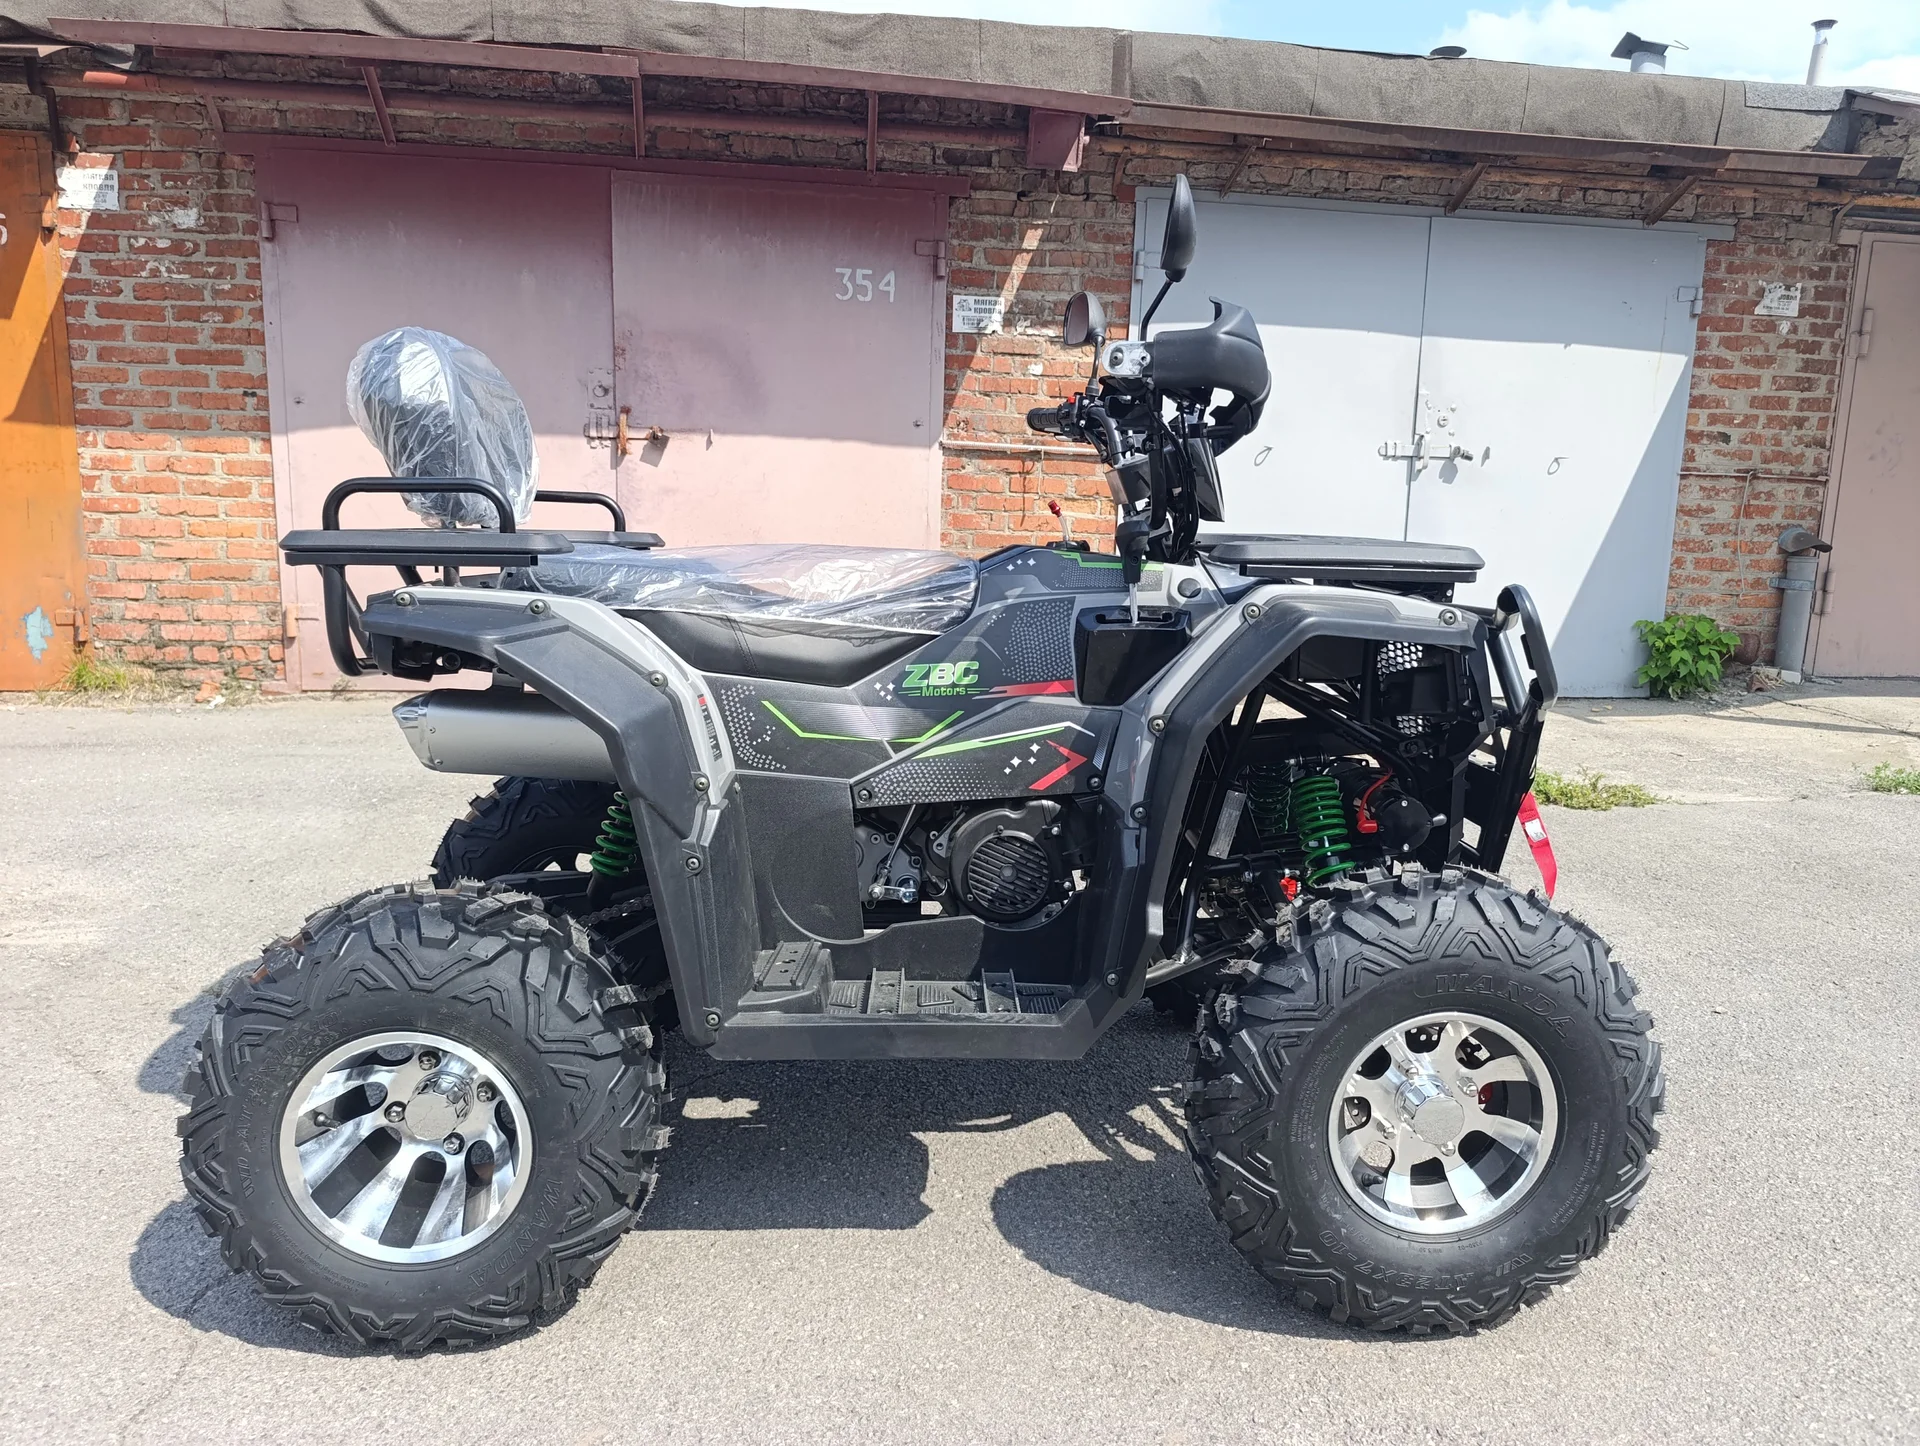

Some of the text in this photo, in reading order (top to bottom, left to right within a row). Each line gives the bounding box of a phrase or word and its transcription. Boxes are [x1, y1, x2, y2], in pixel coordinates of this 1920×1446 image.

[835, 268, 896, 303] 354
[902, 661, 980, 688] ZBC
[921, 686, 966, 697] Motors
[1435, 974, 1577, 1038] WANDA
[468, 1178, 564, 1288] WANDA
